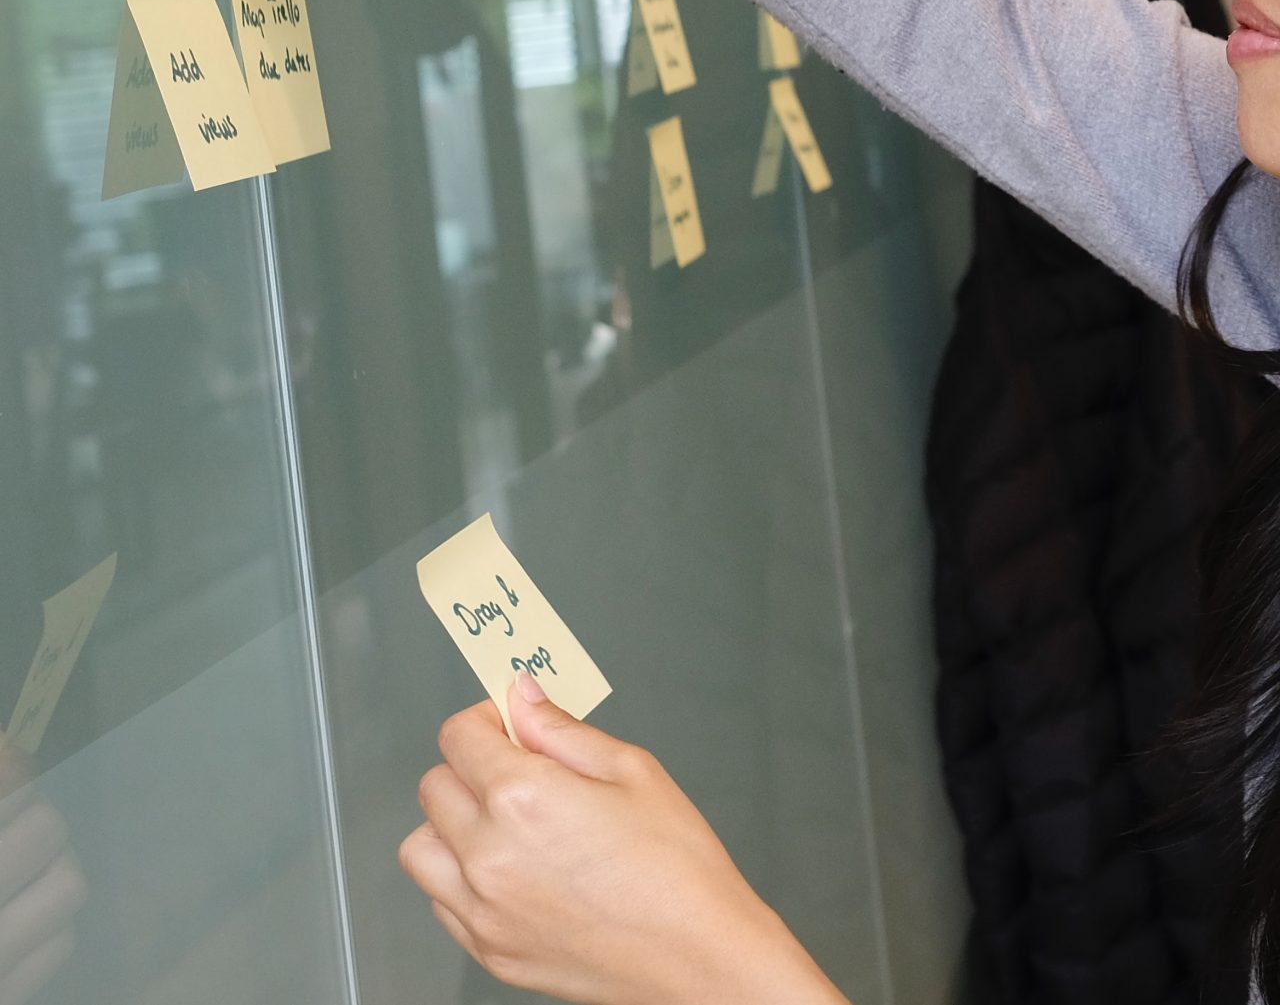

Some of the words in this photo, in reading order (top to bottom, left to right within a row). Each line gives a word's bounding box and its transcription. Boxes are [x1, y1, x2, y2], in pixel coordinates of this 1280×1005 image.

[240, 0, 267, 38] Map
[169, 47, 206, 84] Add
[259, 51, 281, 81] due
[284, 46, 312, 74] dates
[197, 112, 239, 145] views
[452, 600, 515, 638] Drag
